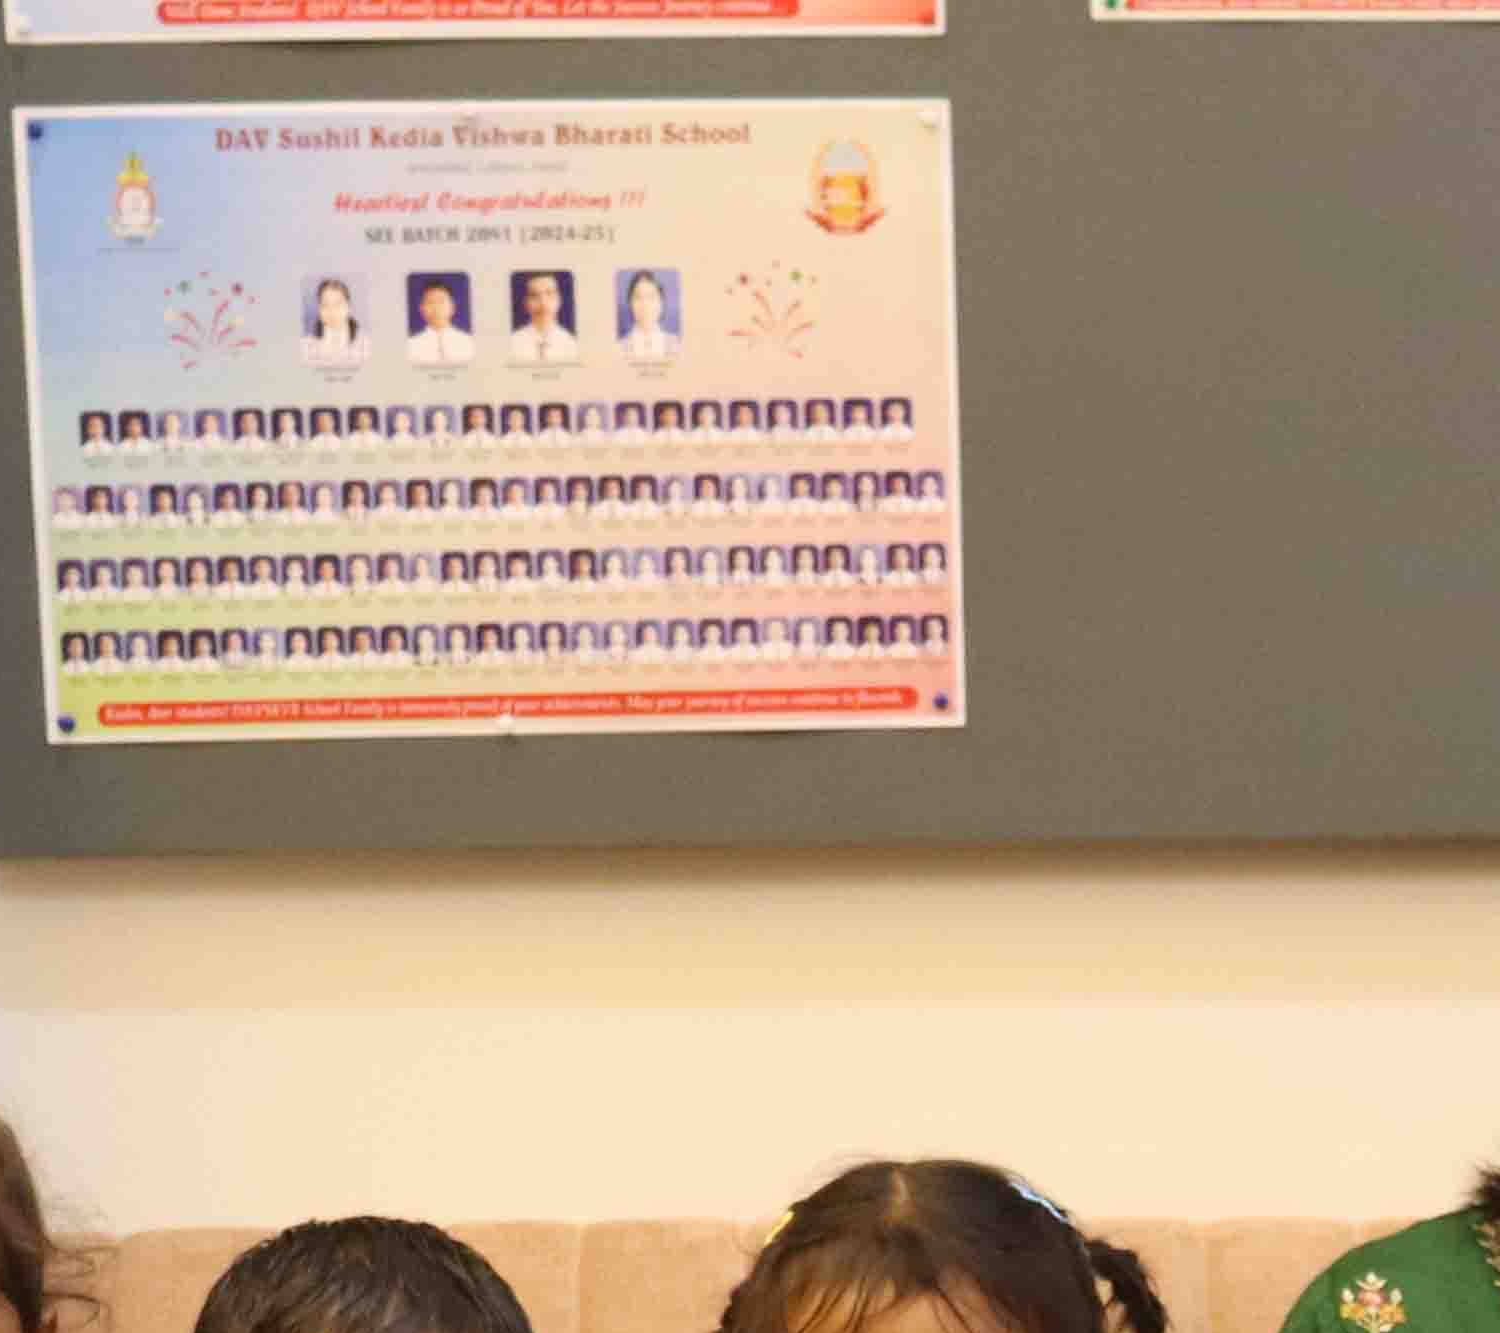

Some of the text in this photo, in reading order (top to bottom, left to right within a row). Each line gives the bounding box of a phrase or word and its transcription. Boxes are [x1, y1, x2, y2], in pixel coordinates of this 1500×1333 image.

[214, 121, 753, 153] DAV Sushil Kedia Vishwa Bharati School
